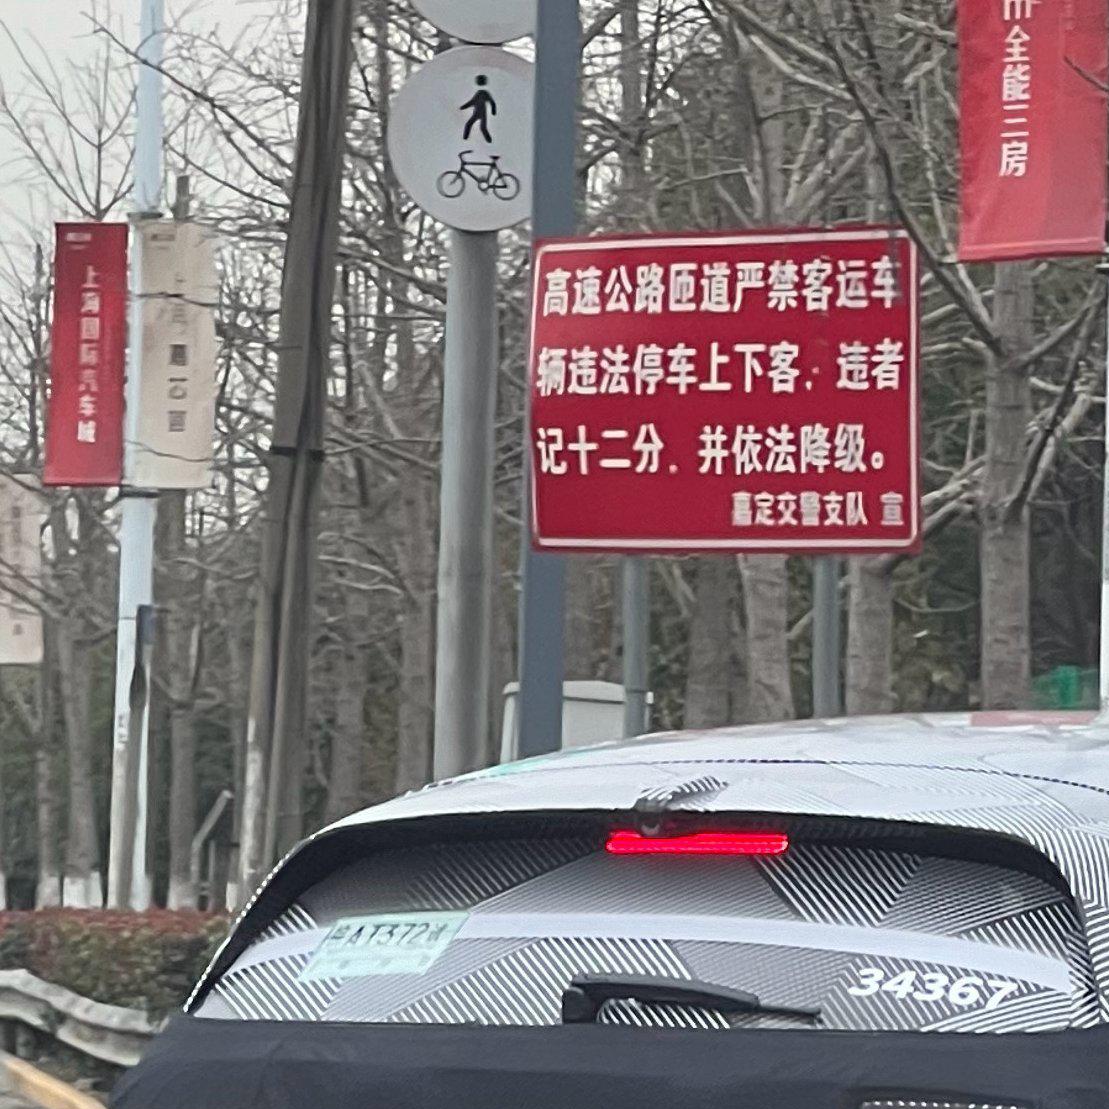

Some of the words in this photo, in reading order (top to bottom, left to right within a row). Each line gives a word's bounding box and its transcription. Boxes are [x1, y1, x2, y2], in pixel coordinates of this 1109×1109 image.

[542, 255, 900, 317] 高速公路匝道严禁客运车
[846, 967, 1018, 1010] 34367
